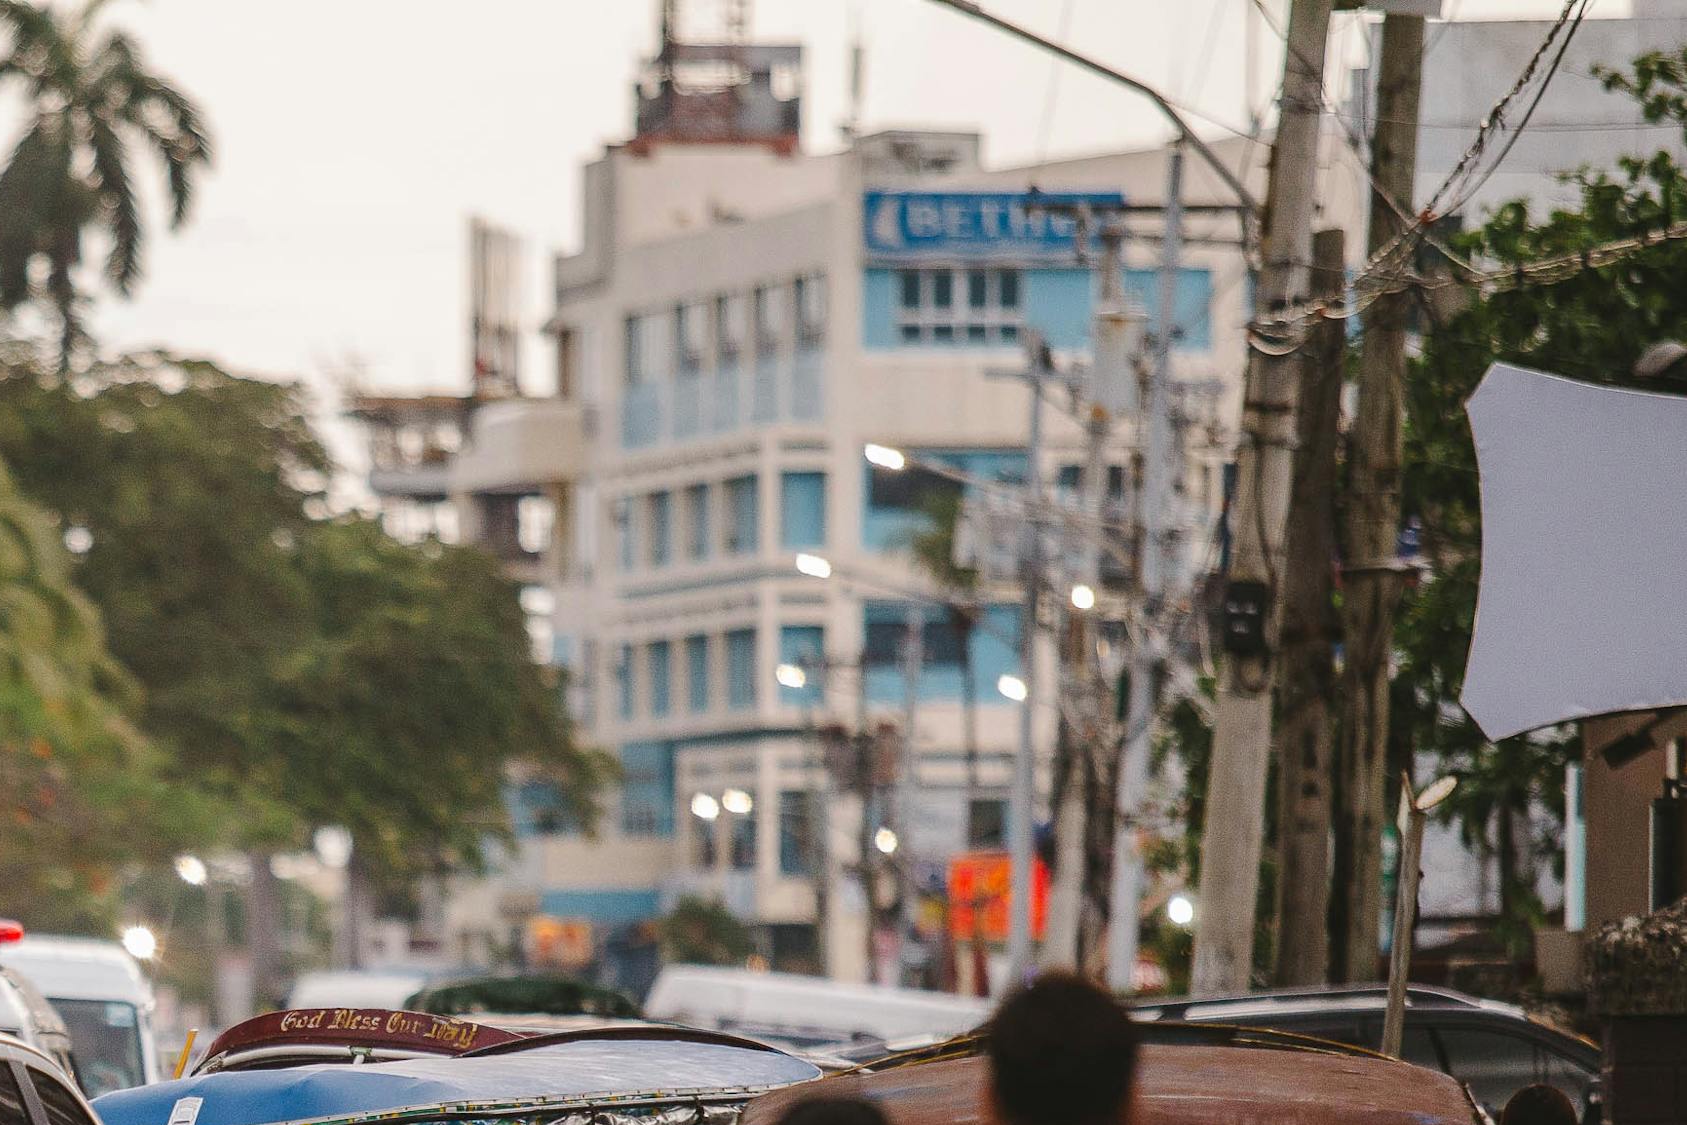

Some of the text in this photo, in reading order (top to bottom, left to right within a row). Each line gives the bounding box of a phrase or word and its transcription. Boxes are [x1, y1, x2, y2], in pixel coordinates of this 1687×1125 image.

[280, 1010, 325, 1032] God
[327, 1009, 381, 1031] Bless
[385, 1012, 425, 1034] Our
